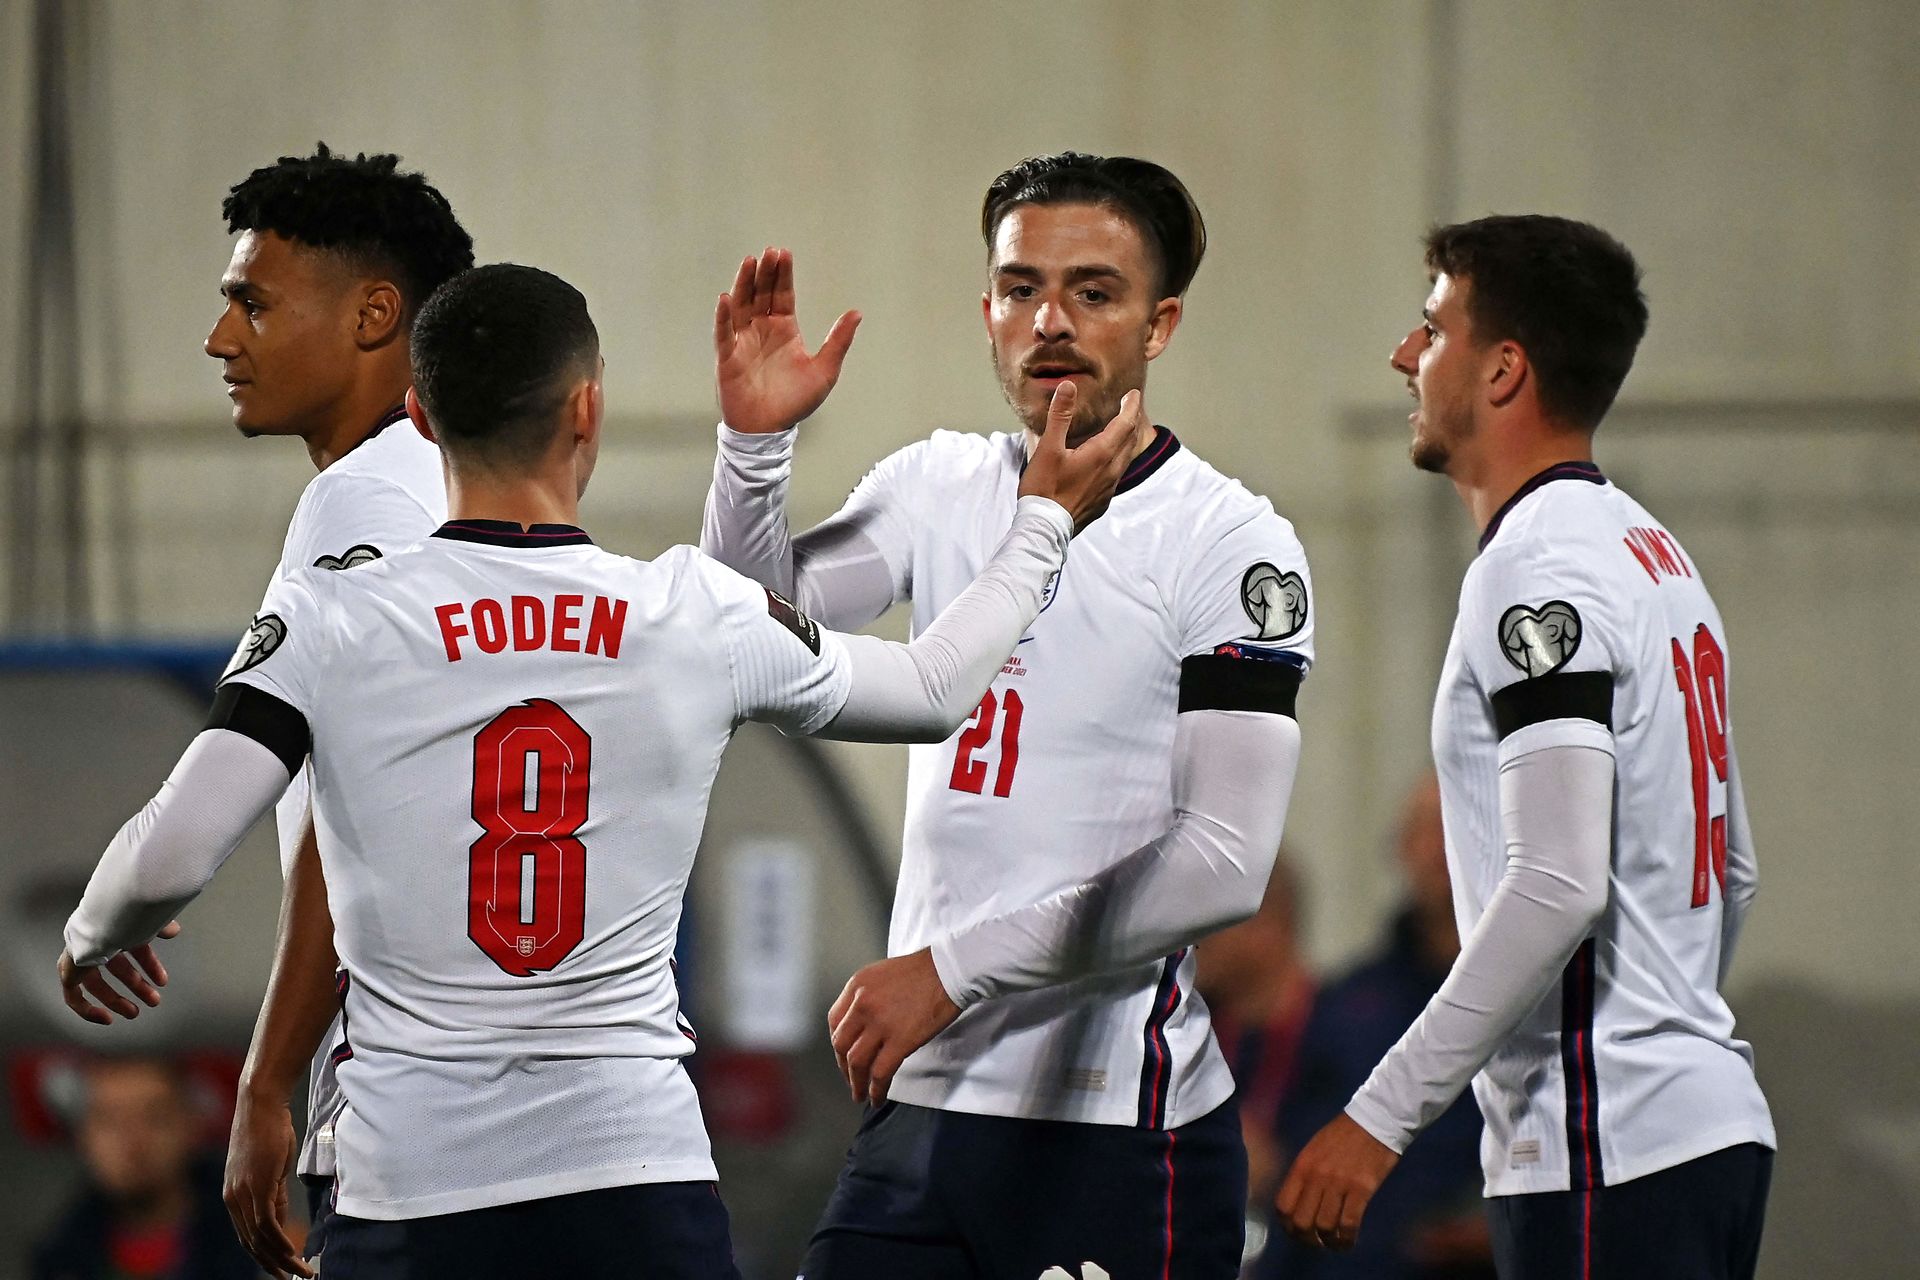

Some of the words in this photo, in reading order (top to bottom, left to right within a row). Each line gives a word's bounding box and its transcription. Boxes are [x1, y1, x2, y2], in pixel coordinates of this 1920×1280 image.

[434, 595, 629, 662] FODEN
[467, 697, 592, 977] 8
[948, 687, 1024, 798] 21
[1671, 622, 1728, 908] 19
